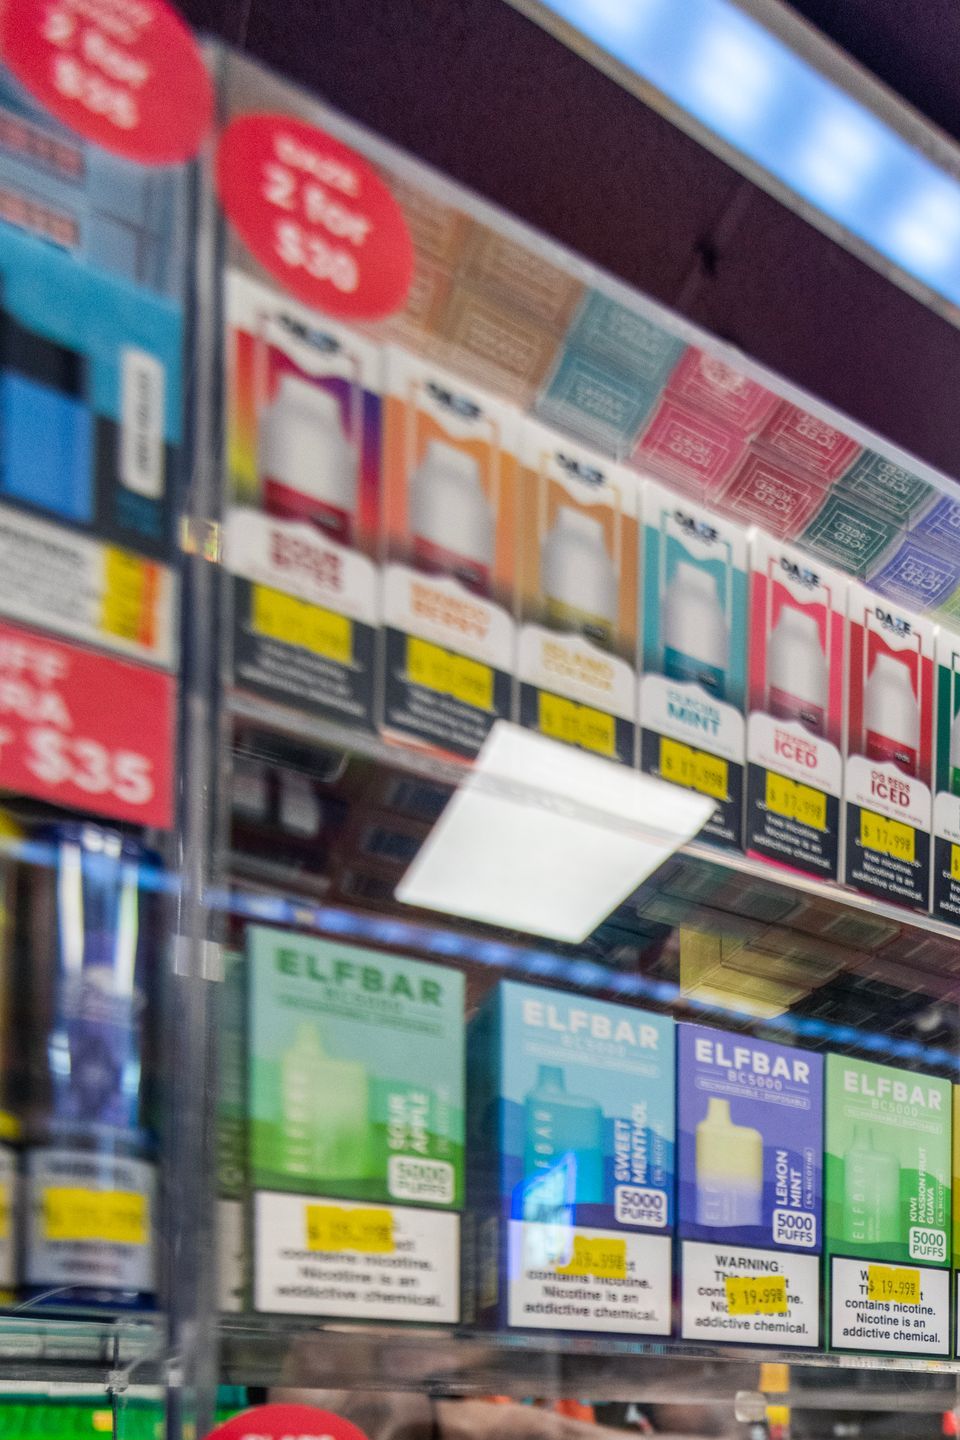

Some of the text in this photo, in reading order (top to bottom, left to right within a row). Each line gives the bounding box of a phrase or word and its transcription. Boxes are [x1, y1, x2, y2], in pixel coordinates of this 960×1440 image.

[875, 608, 912, 631] DAZE
[24, 724, 154, 806] $35
[774, 739, 818, 769] ICED
[871, 779, 911, 808] ICED
[274, 946, 444, 1007] ELFBAR
[522, 1000, 660, 1050] ELFBAR
[695, 1038, 810, 1084] ELFBAR
[727, 1069, 783, 1091] BC5000
[844, 1070, 942, 1111] ELFBAR
[613, 1120, 630, 1182] SWEET
[630, 1100, 648, 1185] MENTHOL
[776, 1151, 788, 1206] LEMON
[790, 1168, 802, 1208] MINT
[918, 1146, 927, 1224] PASSION FRUIT
[926, 1187, 934, 1224] GUAVA
[777, 1213, 813, 1231] 5000
[777, 1228, 813, 1243] PUFFS
[913, 1230, 944, 1247] 5000
[913, 1245, 944, 1258] PUFFS
[715, 1255, 785, 1273] WARNING:
[845, 1298, 936, 1316] contains nicotine.
[856, 1313, 926, 1328] Nicotine is an
[842, 1326, 941, 1344] addictive chemical.
